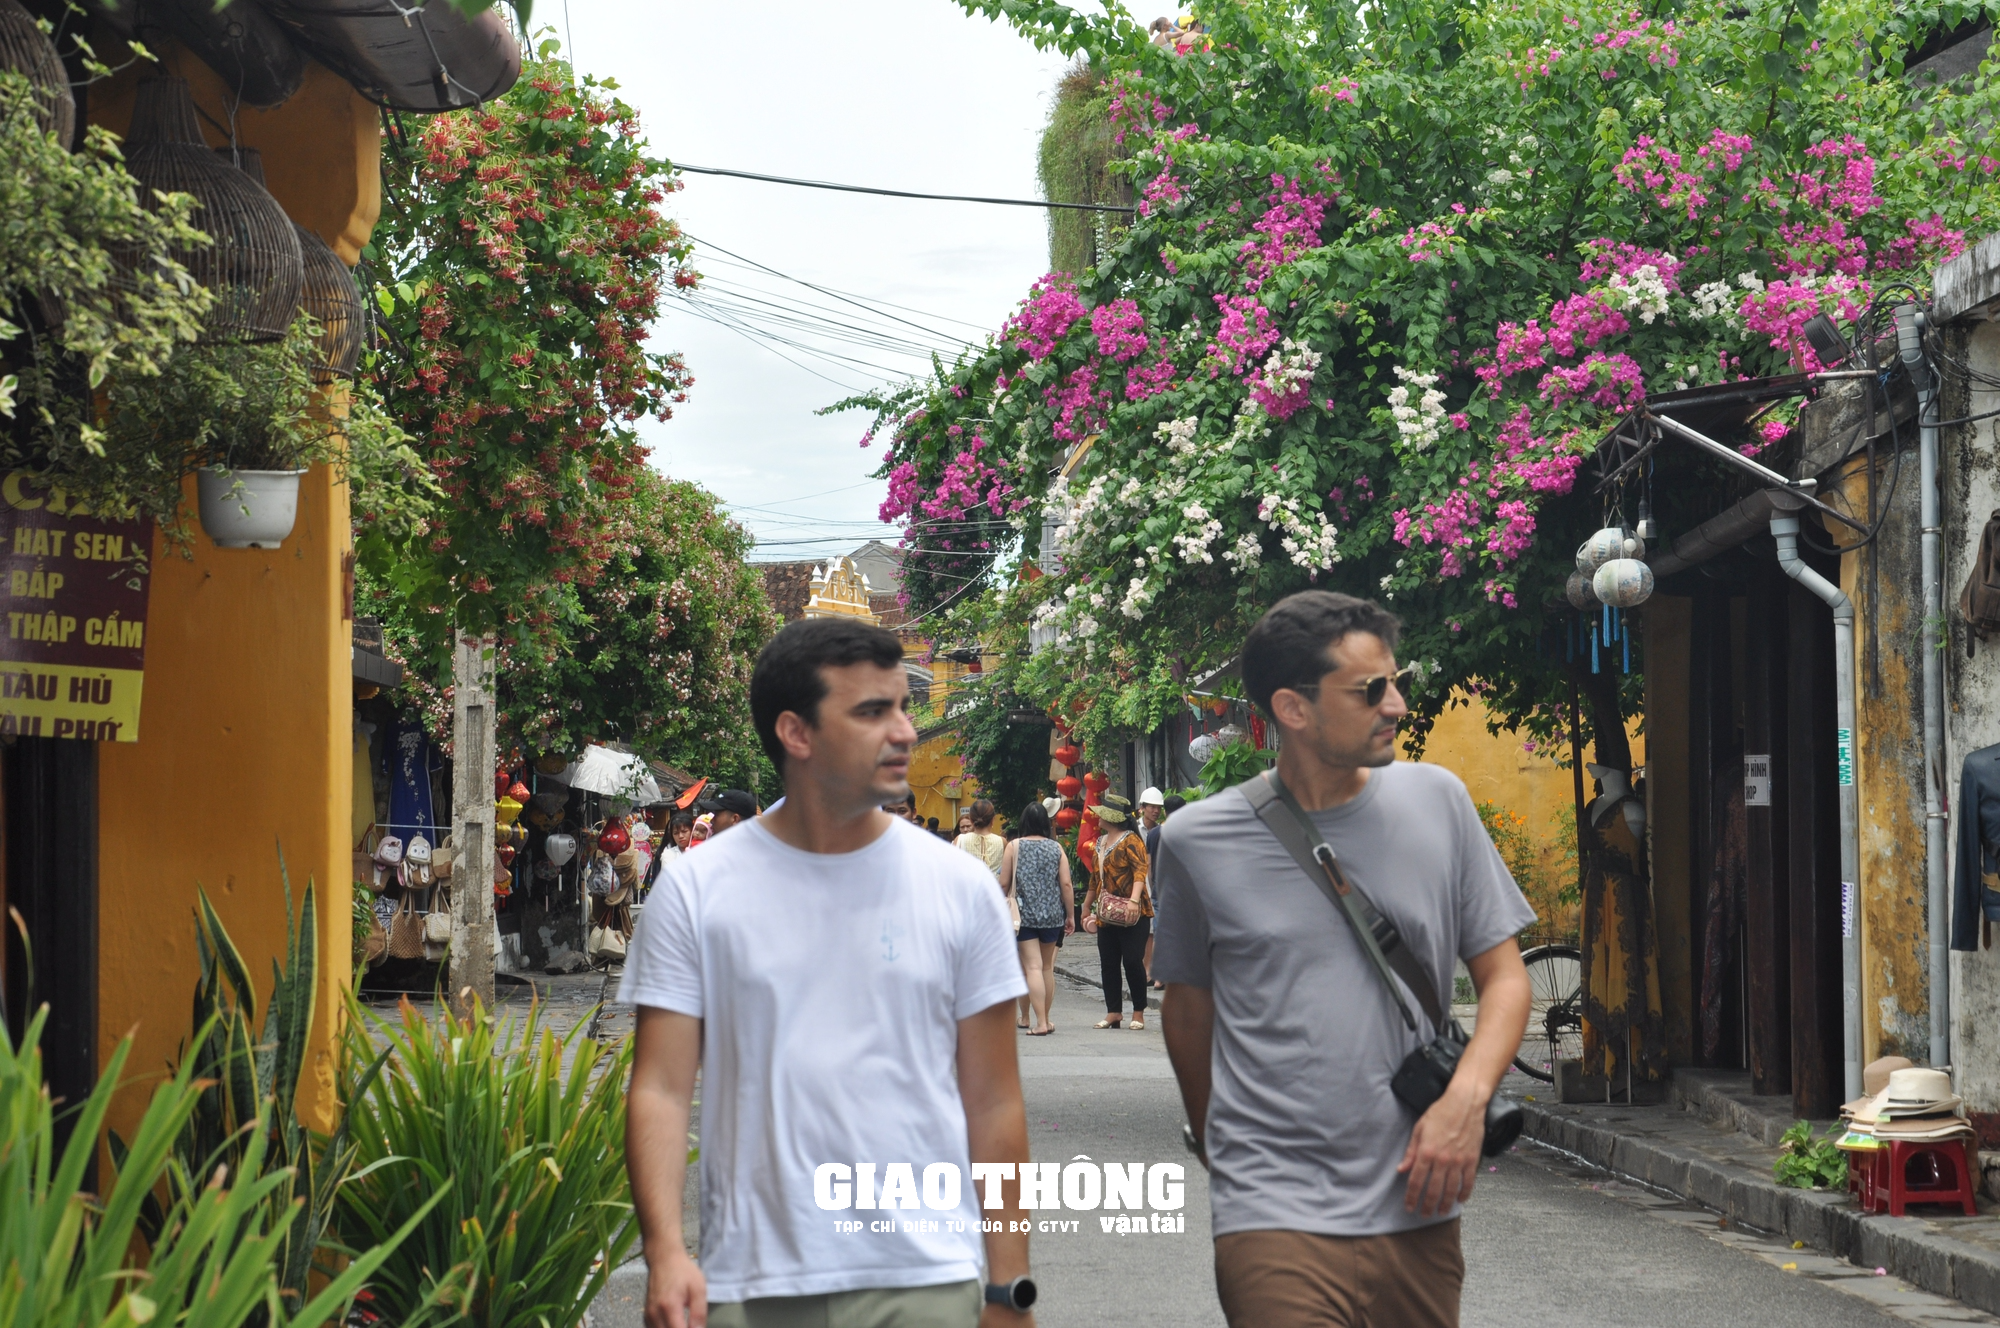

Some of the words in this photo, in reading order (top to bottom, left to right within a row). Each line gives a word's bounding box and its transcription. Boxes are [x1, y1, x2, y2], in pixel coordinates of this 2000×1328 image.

[14, 527, 66, 561] HẠT
[74, 531, 124, 562] SEN
[11, 563, 64, 599] BẮP
[7, 610, 77, 647] THẬP
[85, 610, 143, 648] CẨM
[0, 669, 58, 701] TÀU
[69, 673, 112, 705] HỦ
[0, 710, 42, 736] ÀU
